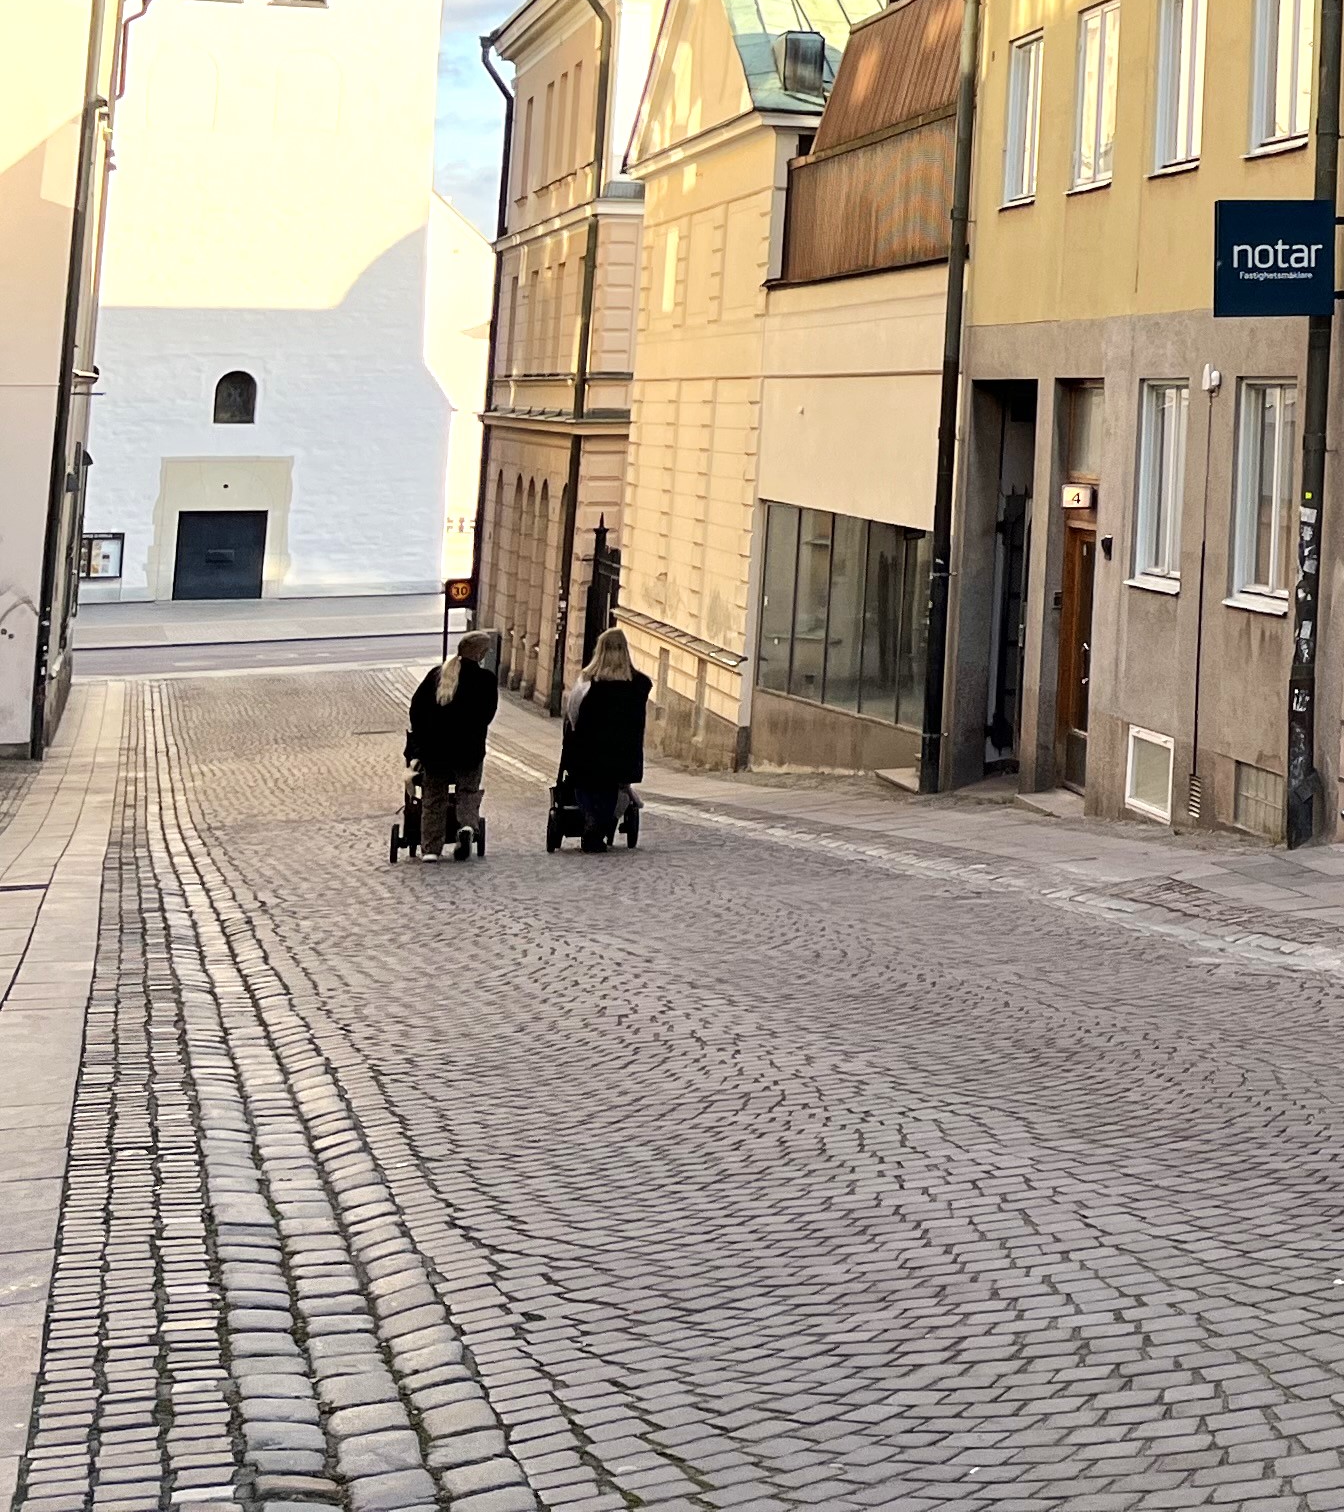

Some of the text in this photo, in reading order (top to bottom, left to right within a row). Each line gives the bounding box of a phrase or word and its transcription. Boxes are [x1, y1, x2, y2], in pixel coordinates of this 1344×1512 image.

[1232, 239, 1323, 268] notar
[1071, 492, 1081, 504] 4
[453, 585, 468, 597] 30
